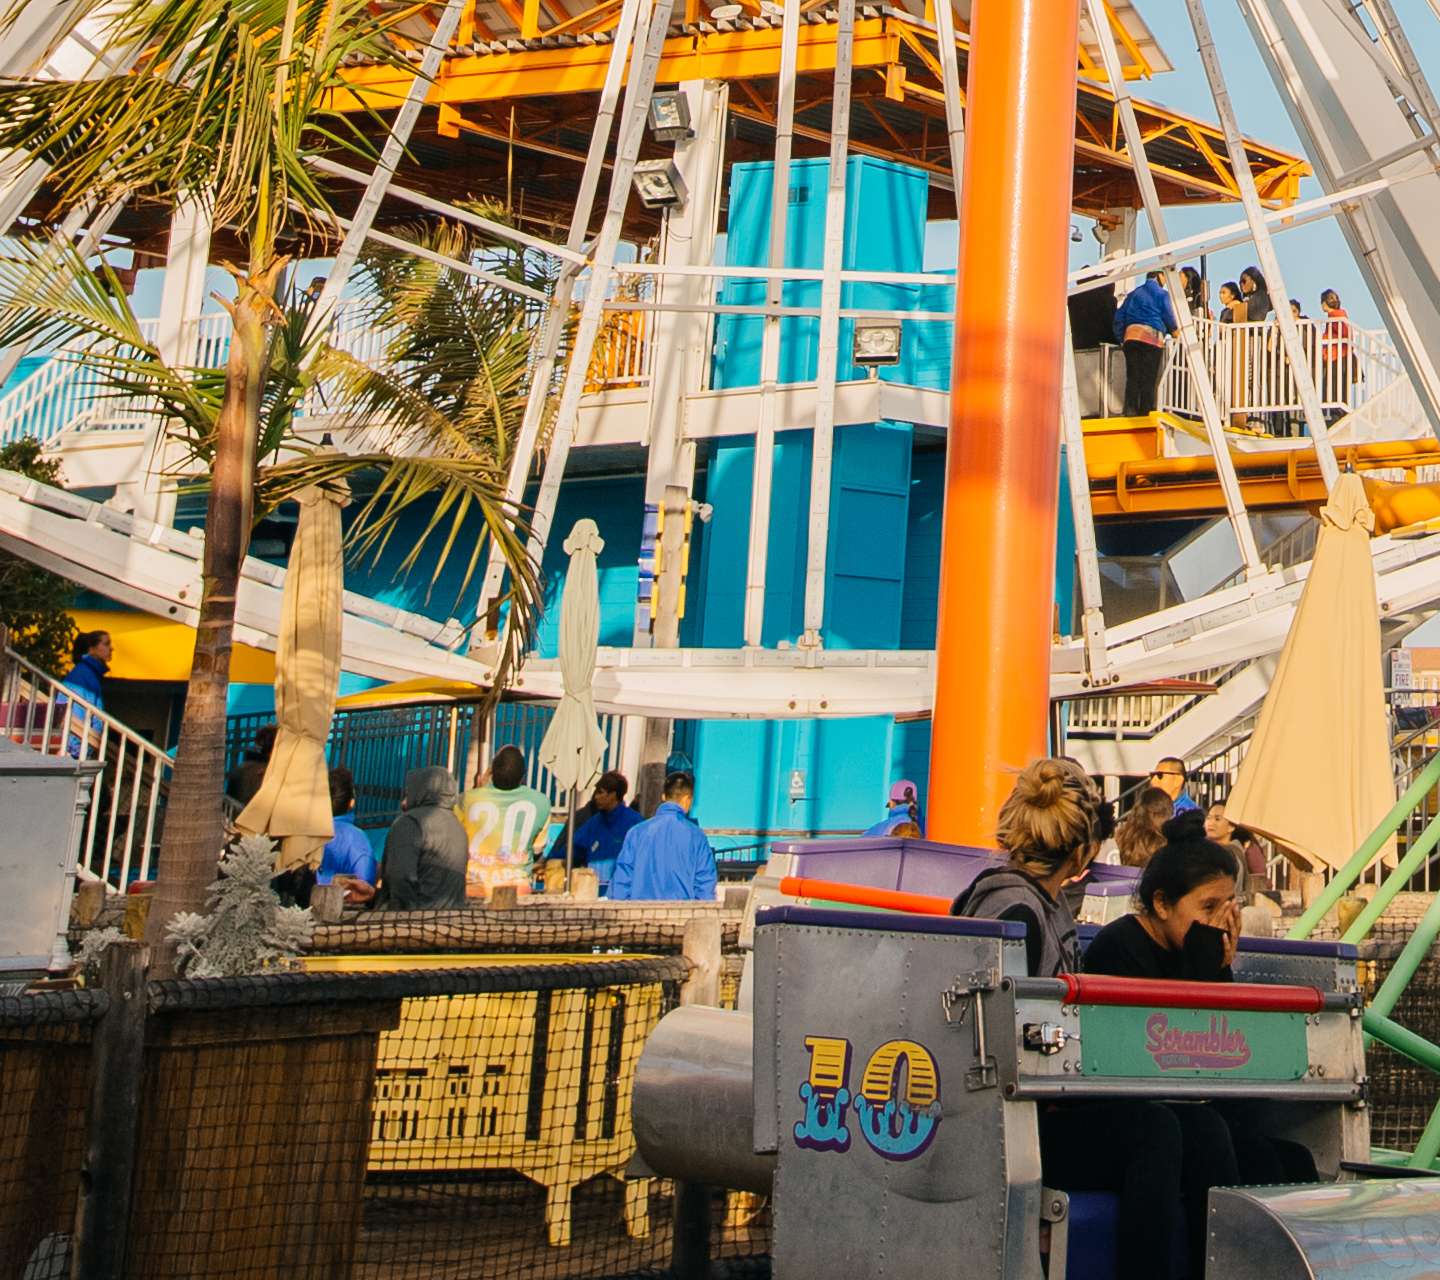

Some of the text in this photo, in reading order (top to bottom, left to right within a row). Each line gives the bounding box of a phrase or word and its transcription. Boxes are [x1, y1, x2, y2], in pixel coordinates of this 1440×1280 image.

[469, 800, 538, 859] 20
[1144, 1012, 1251, 1062] Scrambler
[793, 1034, 943, 1161] 10
